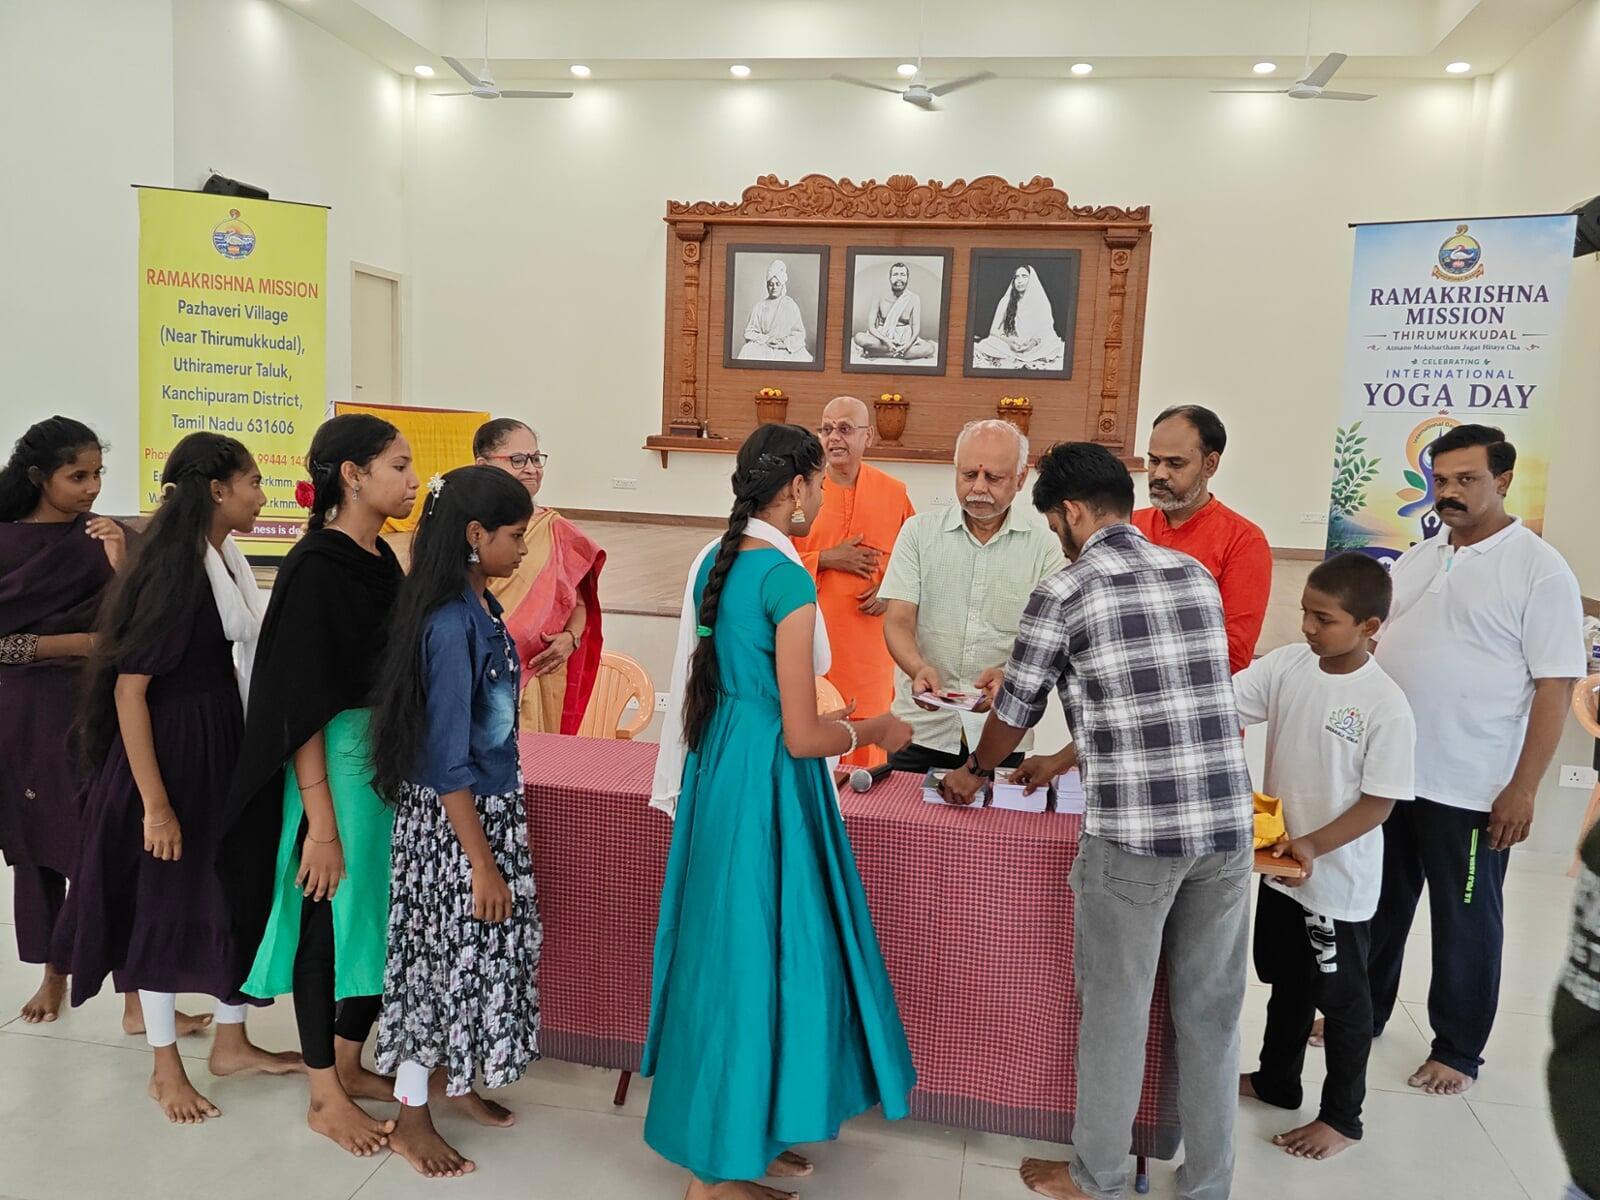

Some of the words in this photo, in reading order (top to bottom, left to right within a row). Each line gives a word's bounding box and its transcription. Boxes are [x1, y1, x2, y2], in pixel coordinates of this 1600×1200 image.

[146, 268, 255, 293] RAMAKRISHNA
[258, 278, 319, 299] MISSION
[1369, 284, 1549, 306] RAMAKRISHNA
[178, 299, 241, 319] Pazhaveri
[244, 304, 288, 326] Village
[1405, 306, 1505, 325] MISSION
[160, 324, 197, 346] (Near
[200, 330, 305, 356] Thirumukkudal),
[1393, 329, 1517, 341] THIRUMUKKUDAL
[173, 357, 253, 377] Uthiramerur
[255, 362, 292, 382] Taluk,
[1422, 358, 1480, 366] CELEBRATING
[1386, 369, 1515, 380] INTERNATIONAL
[162, 384, 249, 406] Kanchipuram
[252, 390, 303, 410] District,
[1363, 382, 1454, 407] YOGA
[1468, 383, 1537, 409] DAY
[172, 413, 205, 430] Tamil
[208, 416, 243, 432] Nadu
[246, 418, 295, 435] 631606
[257, 453, 287, 466] 99444
[278, 524, 286, 535] is
[1465, 875, 1475, 892] POLO
